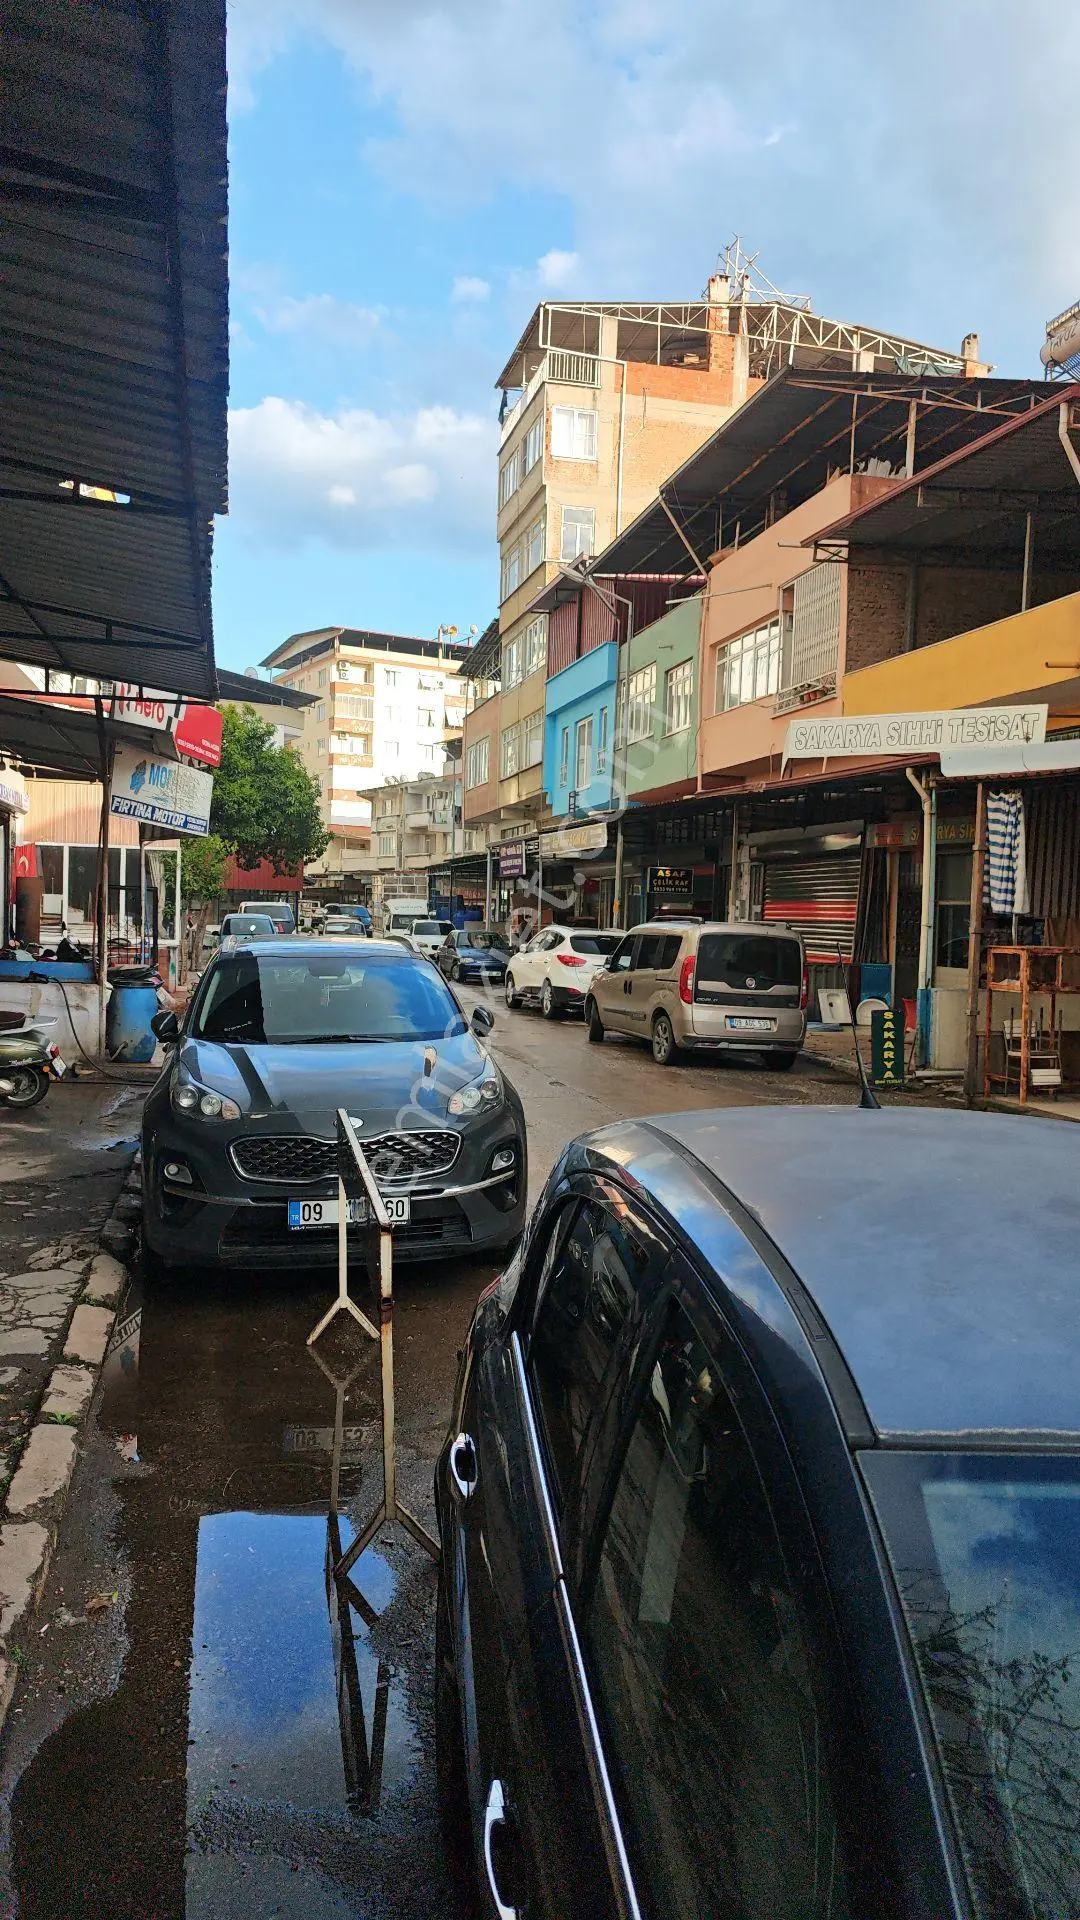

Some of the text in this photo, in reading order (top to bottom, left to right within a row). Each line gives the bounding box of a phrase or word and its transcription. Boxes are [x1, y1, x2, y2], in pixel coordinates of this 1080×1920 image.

[795, 722, 882, 751] SAKARYA
[152, 808, 186, 827] MOTOR
[657, 869, 686, 878] ASAF
[883, 1011, 896, 1078] SAKARYA
[302, 1203, 323, 1222] 09
